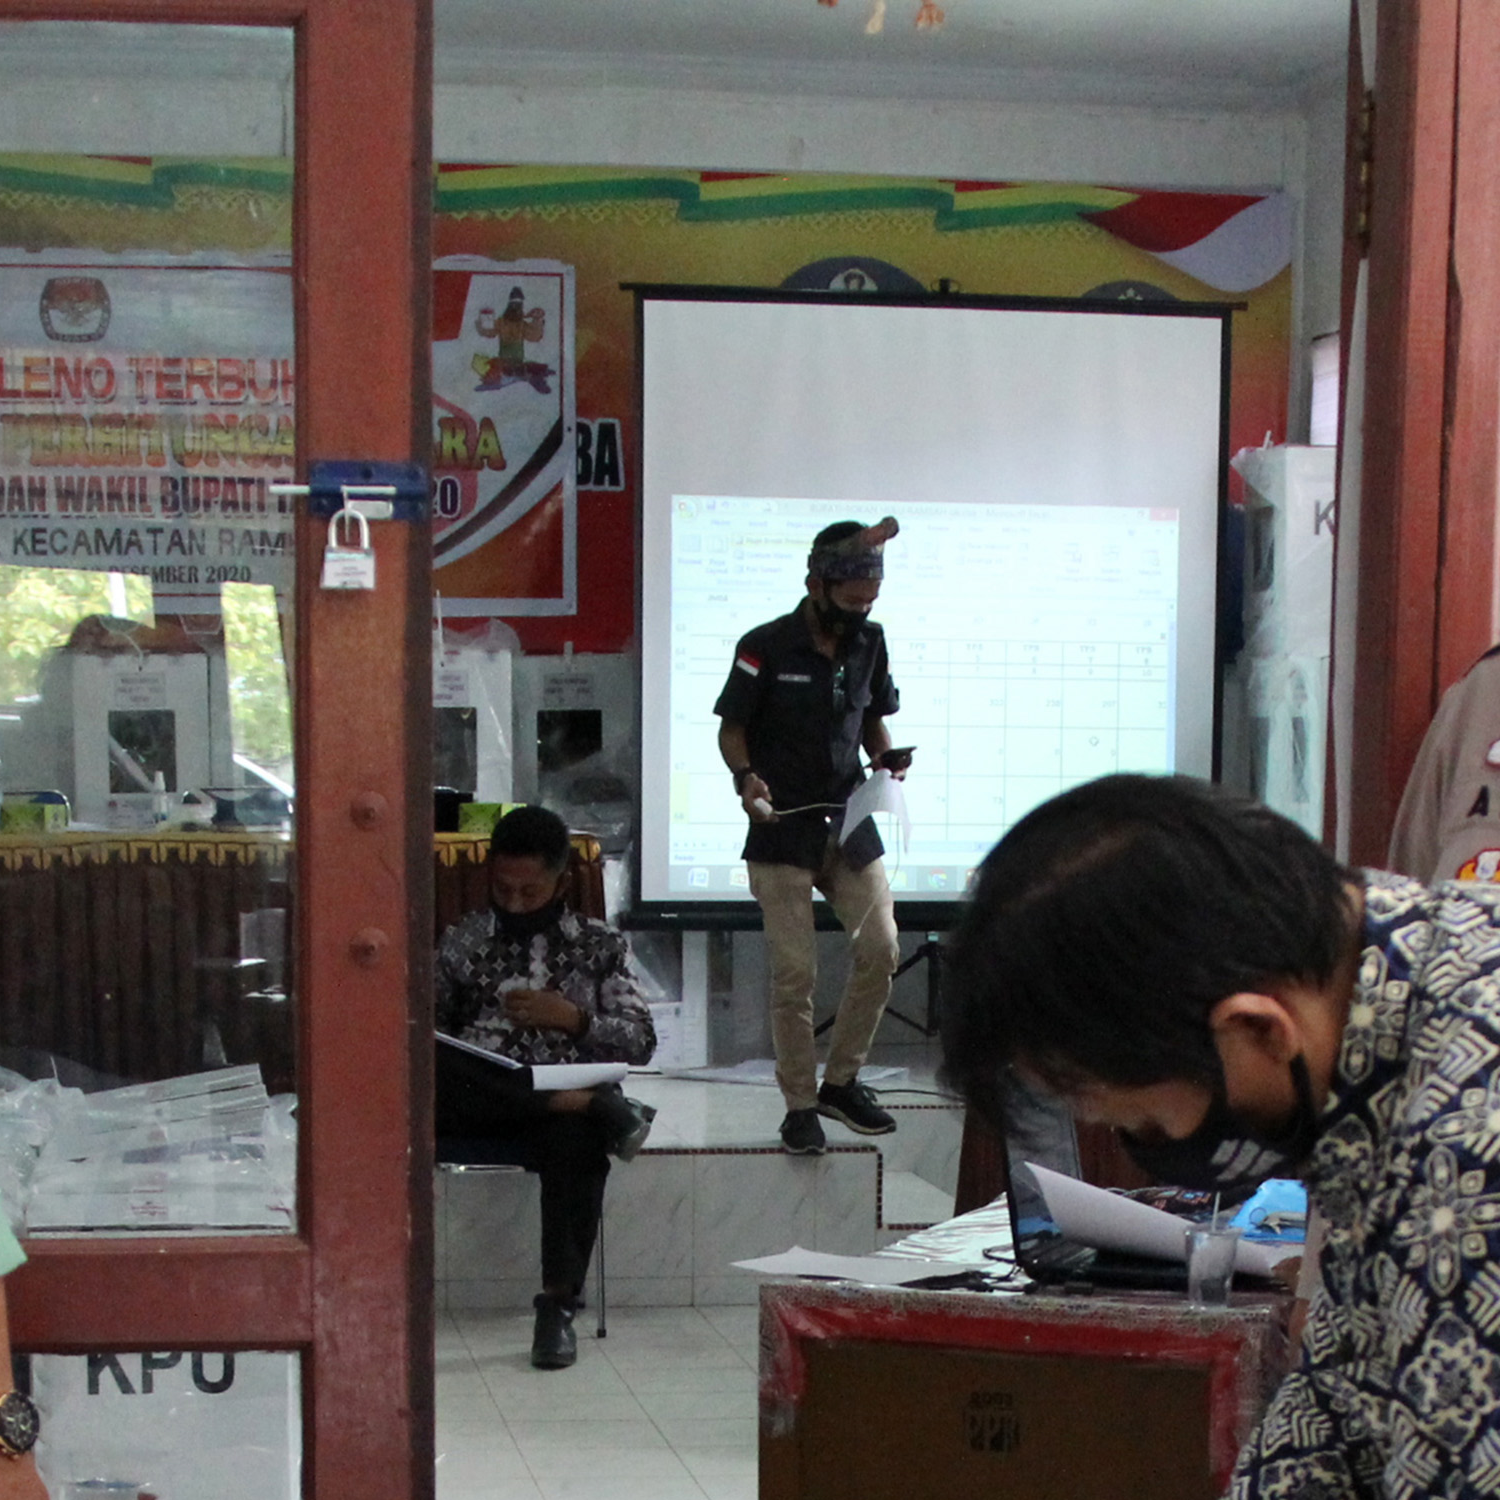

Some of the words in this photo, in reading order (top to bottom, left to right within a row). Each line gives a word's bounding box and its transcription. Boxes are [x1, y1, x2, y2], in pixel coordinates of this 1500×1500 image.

[54, 475, 152, 514] WAKIL
[160, 475, 266, 515] BUPATI
[12, 527, 206, 557] KECAMATAN
[218, 527, 295, 557] RAM
[205, 566, 251, 583] 2020
[87, 1351, 236, 1396] KPU
